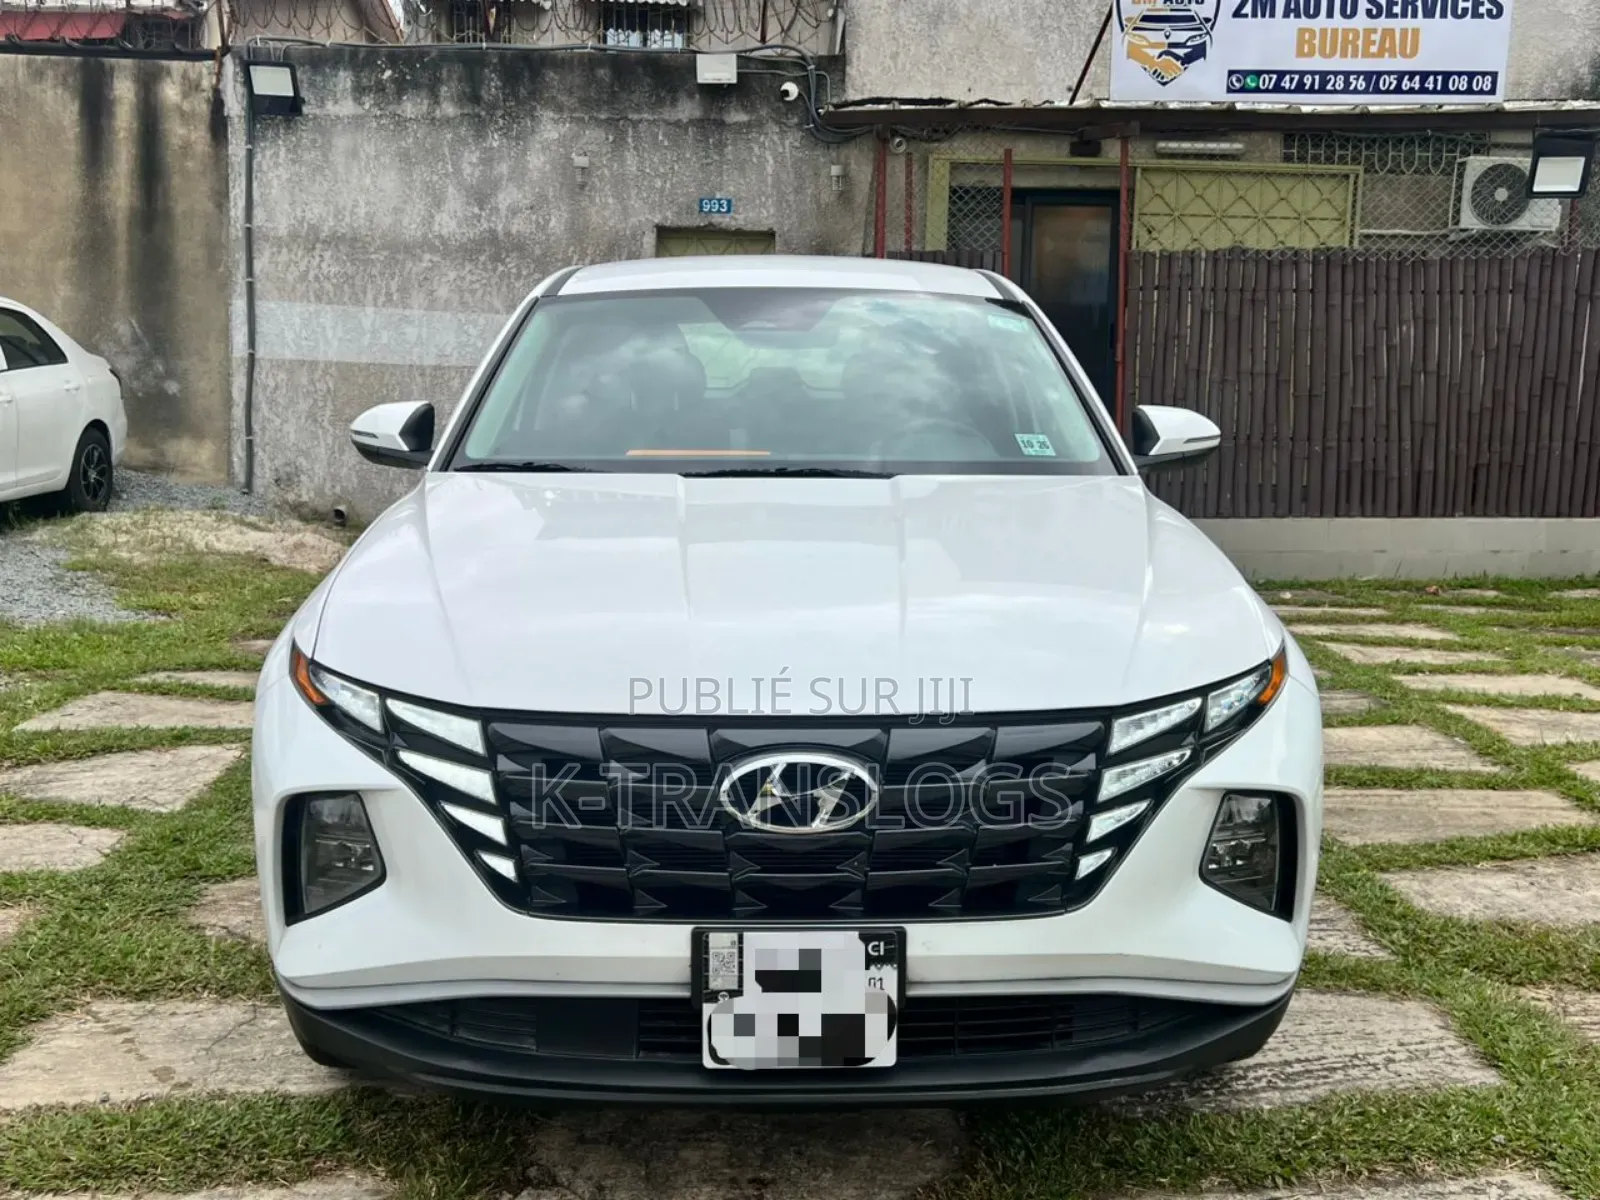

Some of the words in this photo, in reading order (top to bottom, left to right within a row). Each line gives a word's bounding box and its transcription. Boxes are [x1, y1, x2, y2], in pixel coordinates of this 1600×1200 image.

[1231, 0, 1276, 19] 2M
[1282, 0, 1360, 19] AUTO
[1365, 0, 1504, 20] SERVICES
[1295, 27, 1421, 60] BUREAU
[1259, 74, 1278, 90] 07
[1281, 74, 1300, 90] 47
[1303, 74, 1320, 90] 91
[1326, 74, 1345, 91] 28
[1348, 74, 1366, 91] 56
[1379, 74, 1398, 91] 05
[1401, 74, 1420, 91] 64
[1424, 74, 1443, 91] 41
[1448, 75, 1468, 91] 08
[1472, 75, 1492, 92] 08
[702, 199, 728, 212] 993
[867, 941, 885, 956] CI
